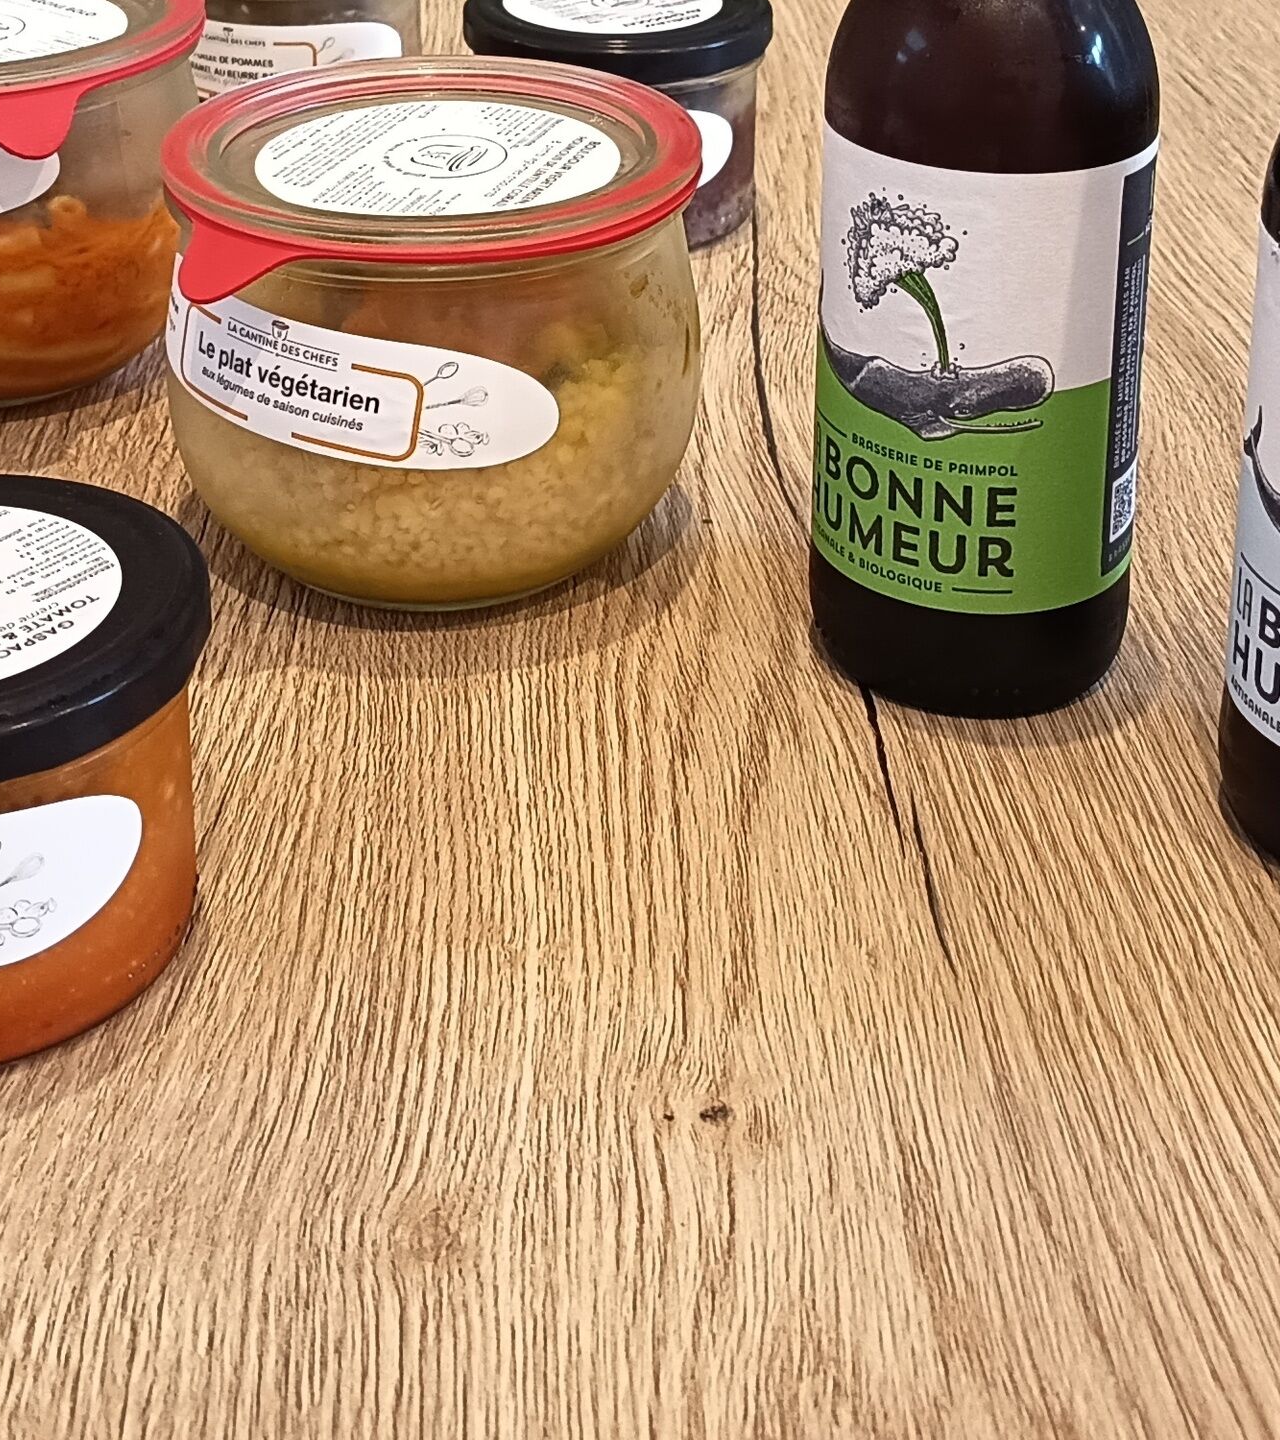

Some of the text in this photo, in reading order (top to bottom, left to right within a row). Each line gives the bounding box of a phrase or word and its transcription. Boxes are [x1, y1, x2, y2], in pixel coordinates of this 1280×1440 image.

[214, 67, 227, 76] AU
[227, 69, 259, 80] BEURRE
[218, 55, 231, 65] DE
[231, 57, 274, 68] POMMES
[227, 320, 339, 367] LA CANTINE DES CHEFS
[198, 331, 380, 414] Le plat végétarien
[201, 365, 364, 432] aux légumes de saison cuisinés
[851, 433, 1018, 477] BRASSERIE DE PAIMPOL
[825, 434, 1017, 528] BONNE
[848, 551, 855, 563] &
[859, 558, 943, 594] BIOLOGIQUE
[19, 595, 100, 633] TOMATE
[1237, 566, 1253, 627] LA
[1, 632, 18, 640] &
